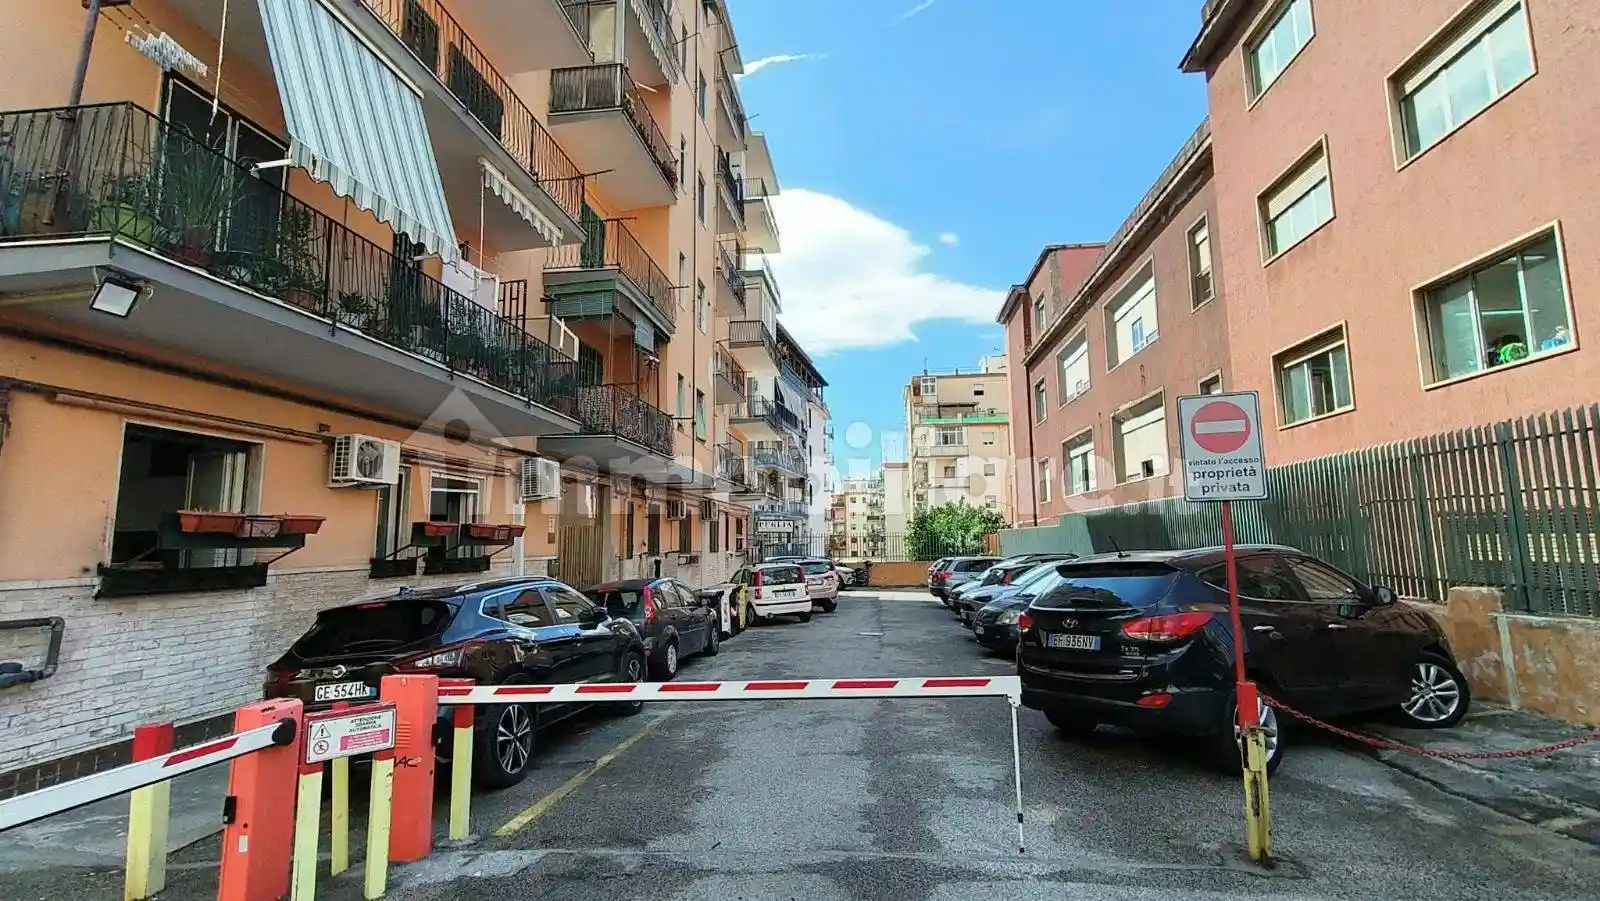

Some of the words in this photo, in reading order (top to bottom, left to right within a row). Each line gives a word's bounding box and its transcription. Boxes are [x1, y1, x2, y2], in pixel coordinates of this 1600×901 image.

[1219, 457, 1260, 465] l'accesso
[1193, 466, 1257, 481] proprietà
[1202, 482, 1250, 495] privata
